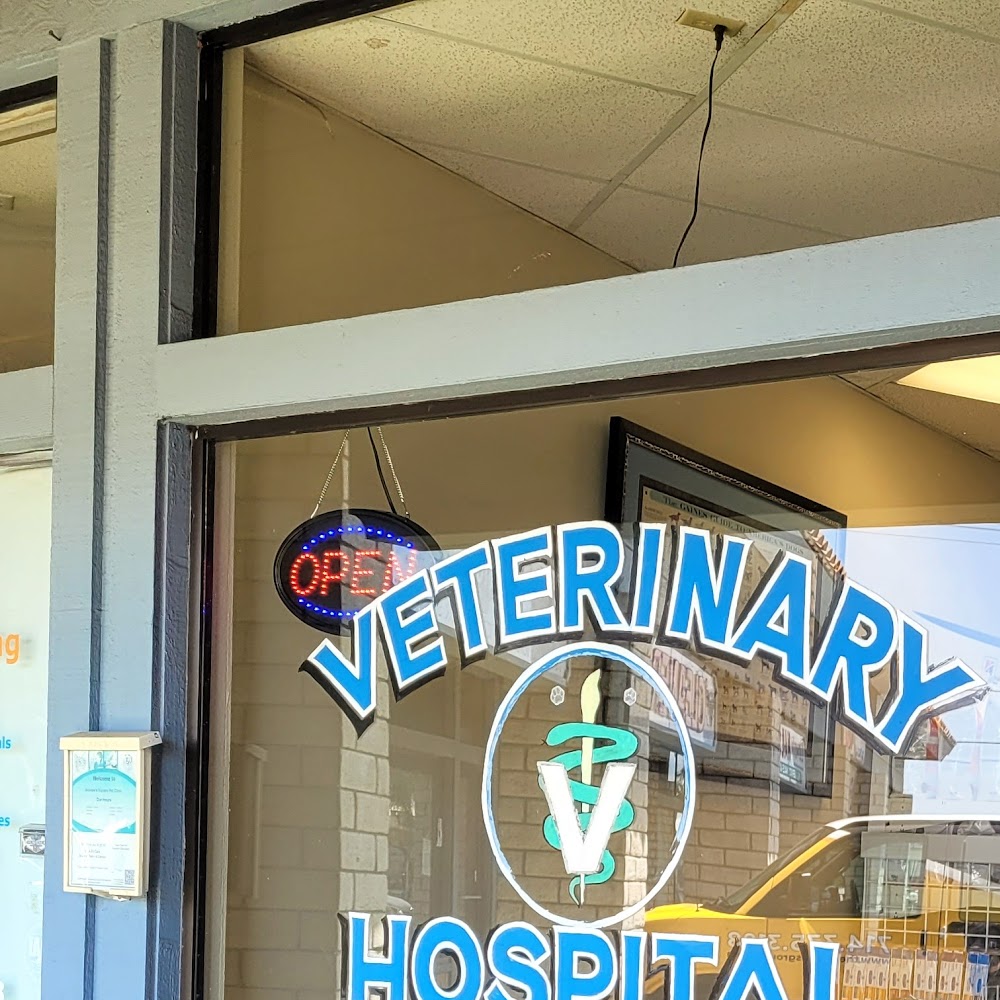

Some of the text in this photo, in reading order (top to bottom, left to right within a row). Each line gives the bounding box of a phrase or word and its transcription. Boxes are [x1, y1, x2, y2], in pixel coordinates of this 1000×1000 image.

[680, 504, 708, 519] GAINES
[289, 549, 417, 597] OPEN
[302, 520, 987, 753] VETERINARY
[537, 762, 637, 874] V
